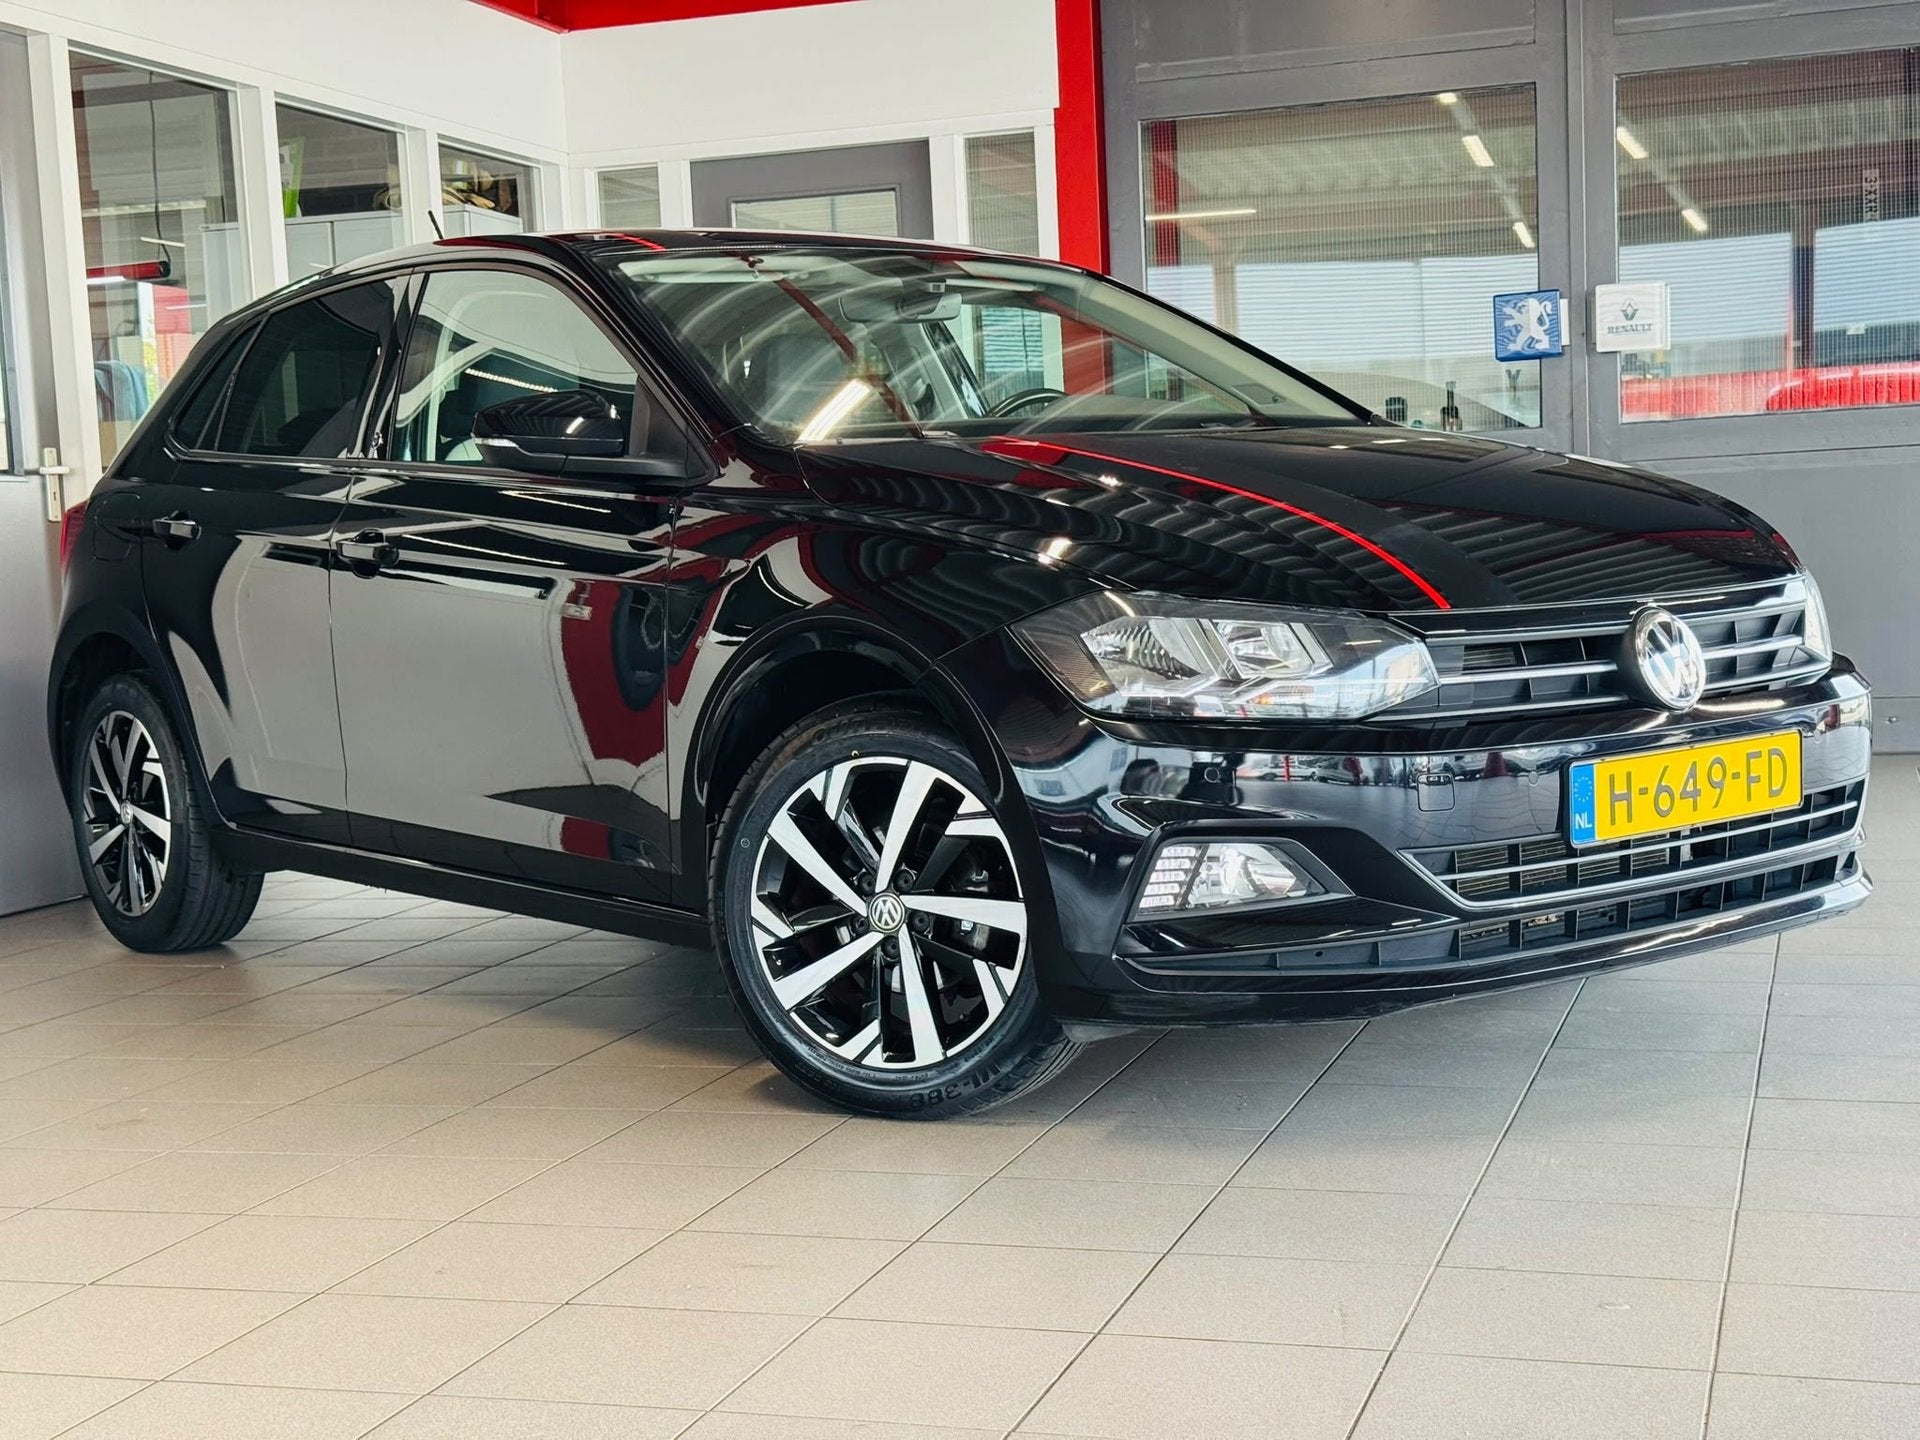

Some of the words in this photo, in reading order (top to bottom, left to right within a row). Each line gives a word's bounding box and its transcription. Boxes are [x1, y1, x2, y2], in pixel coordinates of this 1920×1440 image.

[1607, 323, 1654, 335] RENAULT
[1575, 811, 1593, 830] NL
[1608, 747, 1788, 826] H-649-FD
